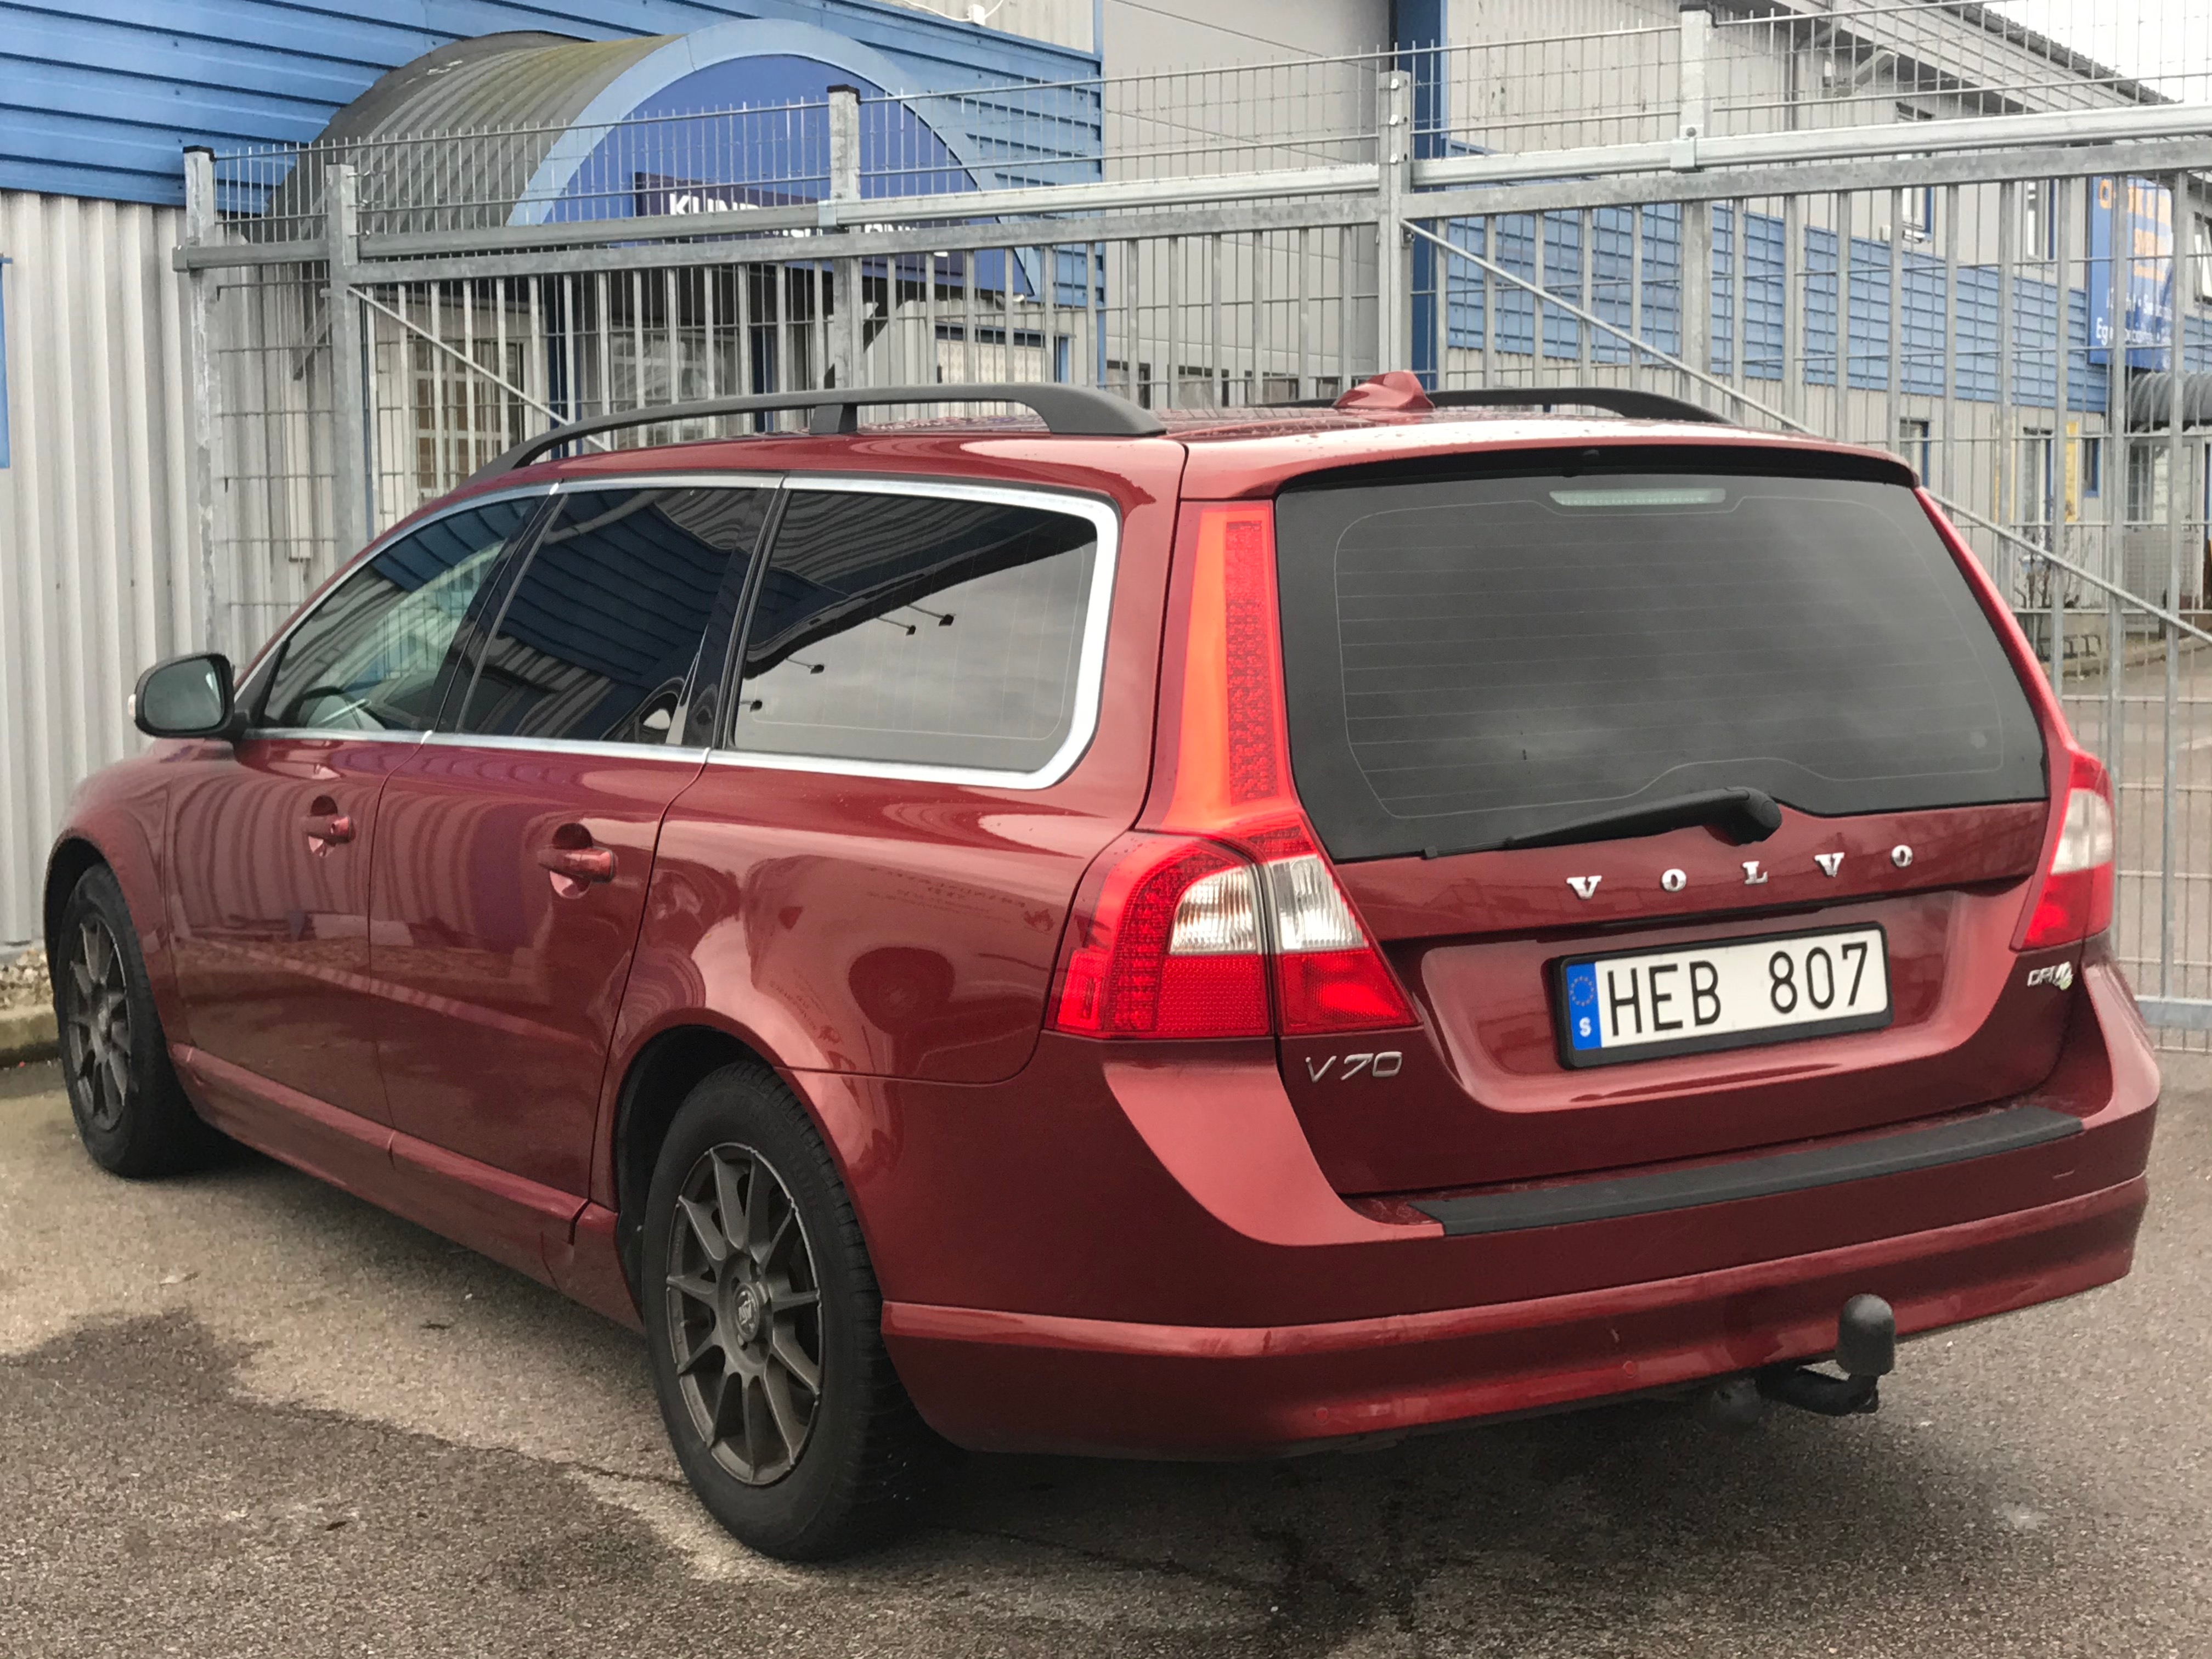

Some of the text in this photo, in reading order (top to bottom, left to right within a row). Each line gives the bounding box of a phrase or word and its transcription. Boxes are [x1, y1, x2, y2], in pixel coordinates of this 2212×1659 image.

[1567, 845, 1913, 899] VOLVO
[1607, 941, 1868, 1037] HEB 807
[1580, 1017, 1590, 1037] S
[1306, 1051, 1402, 1083] V70
